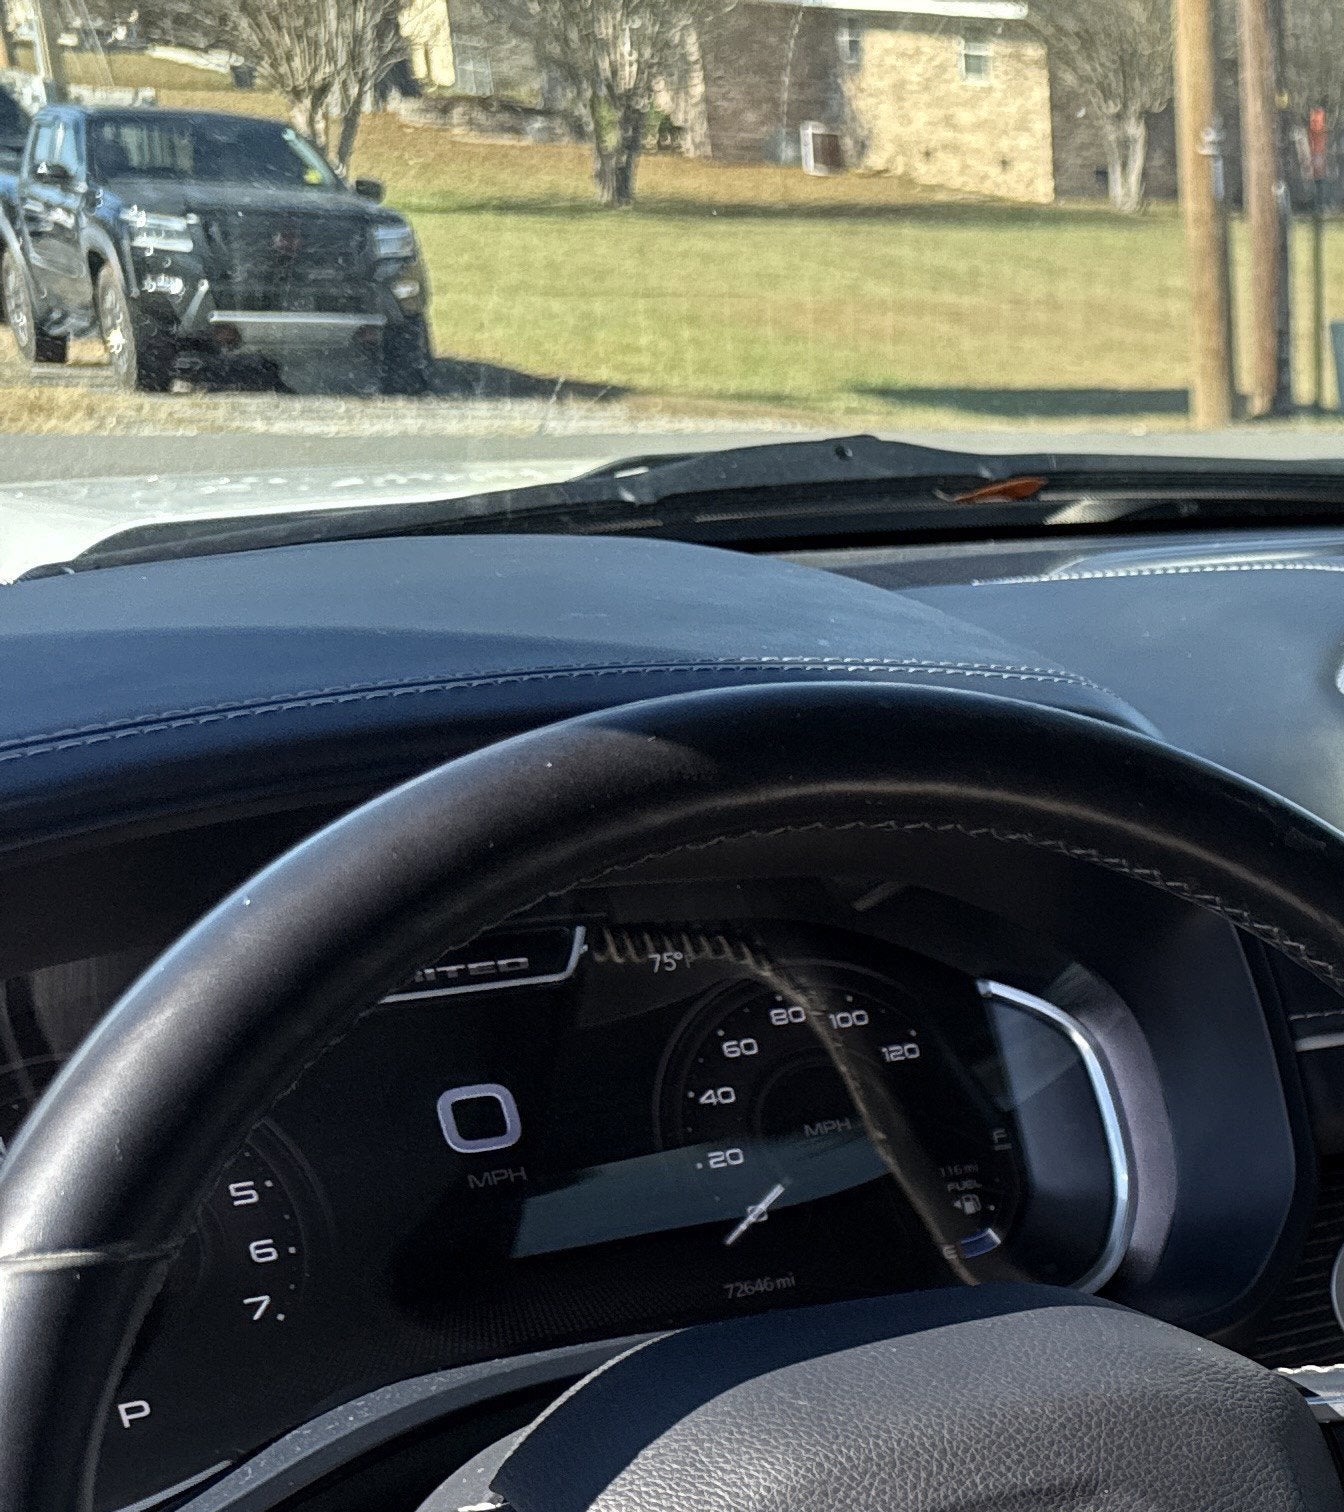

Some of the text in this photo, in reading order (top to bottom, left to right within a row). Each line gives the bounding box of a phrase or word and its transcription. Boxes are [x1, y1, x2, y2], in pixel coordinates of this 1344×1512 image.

[414, 957, 529, 981] ITED
[768, 1005, 806, 1027] 80
[828, 1009, 869, 1030] 100
[722, 1037, 759, 1059] 60
[880, 1041, 921, 1062] 120
[699, 1086, 737, 1106] 40
[436, 1083, 522, 1154] 0
[802, 1118, 852, 1138] MPH
[707, 1148, 744, 1169] 20
[466, 1166, 528, 1189] MPH
[228, 1180, 260, 1207] 5
[248, 1239, 278, 1264] 6
[242, 1295, 271, 1322] 7
[117, 1400, 151, 1429] P
